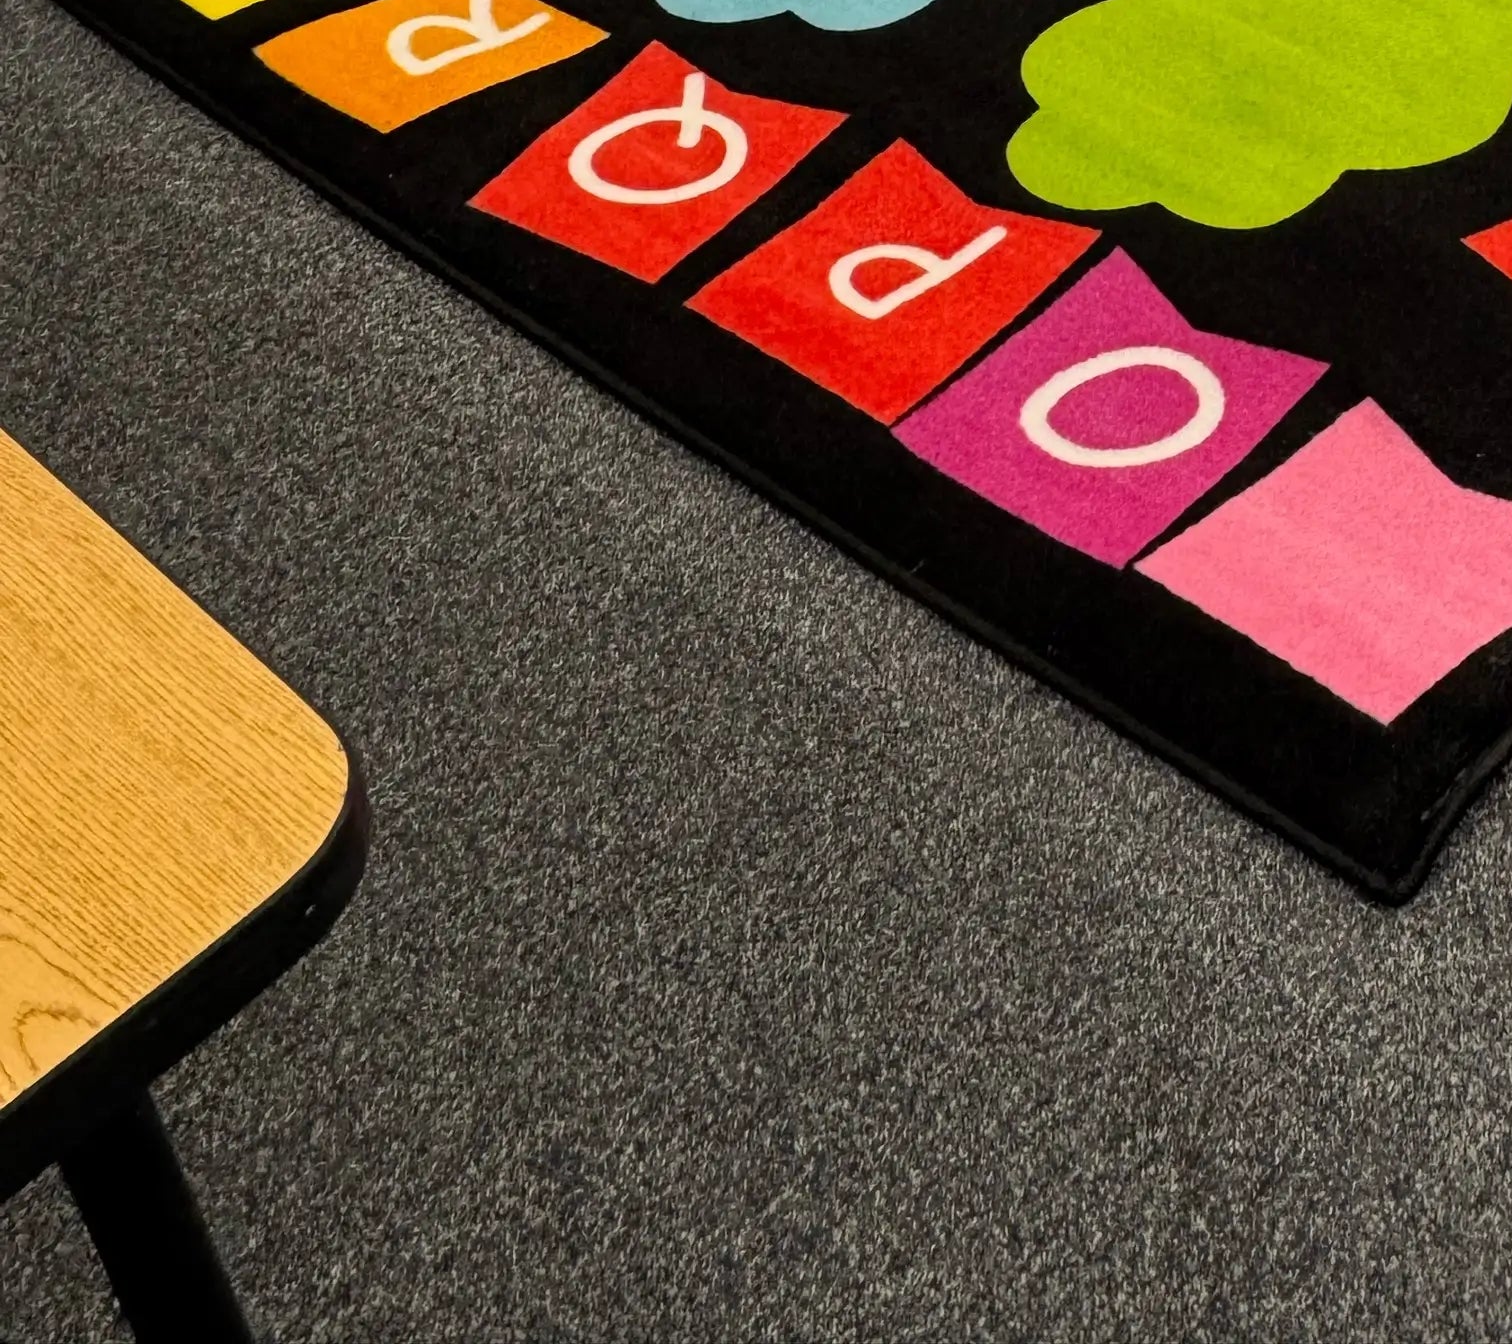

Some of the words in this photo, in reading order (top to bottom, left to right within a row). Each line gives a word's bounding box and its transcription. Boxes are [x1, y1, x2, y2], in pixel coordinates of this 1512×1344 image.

[567, 71, 749, 206] Q
[828, 223, 1009, 321] P
[1020, 344, 1226, 468] O
